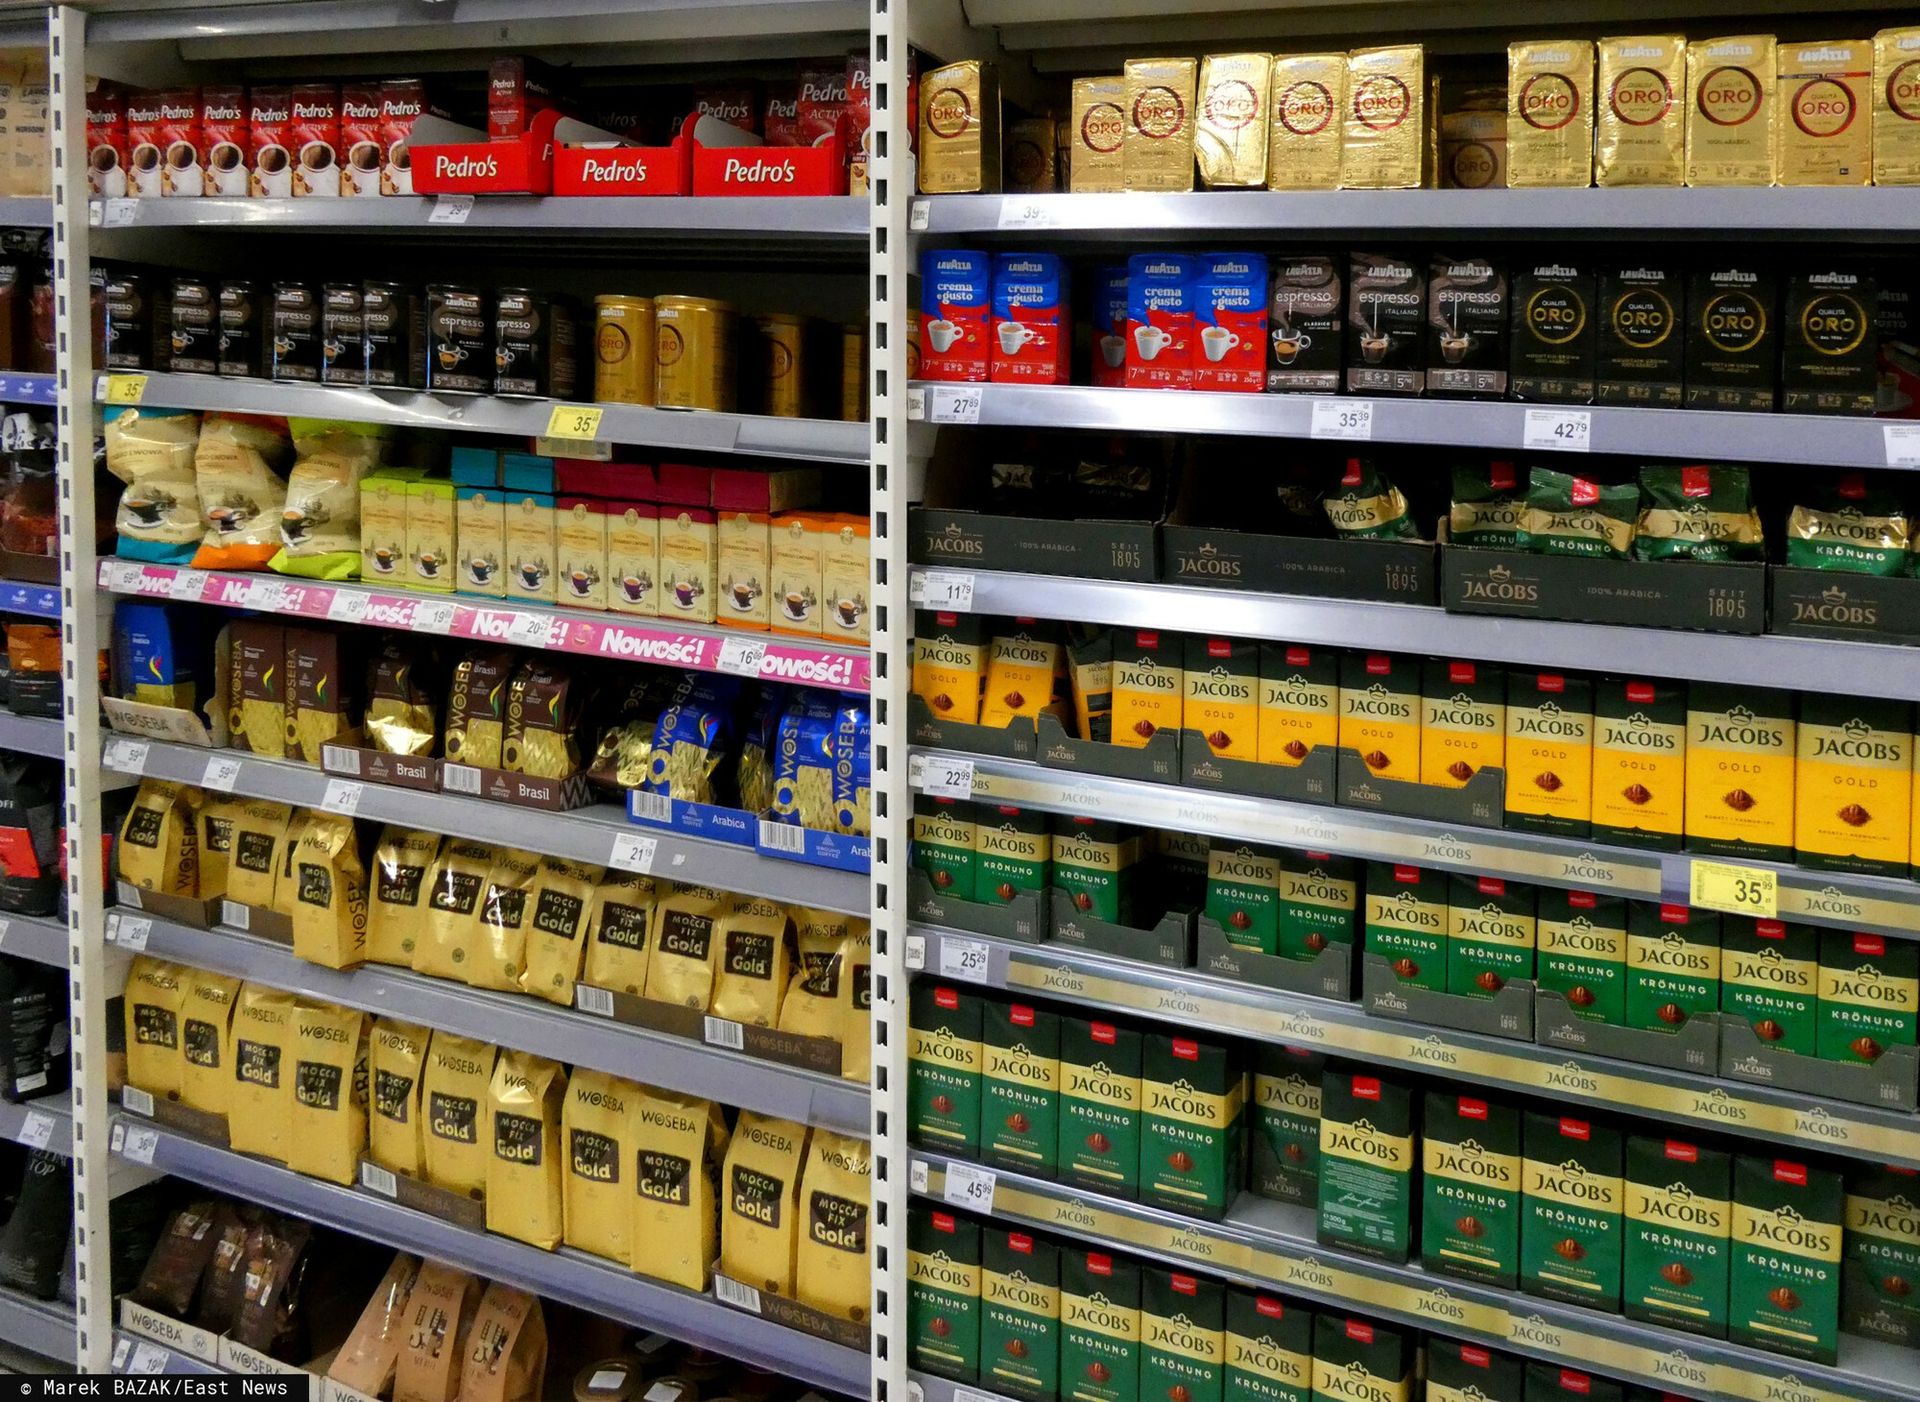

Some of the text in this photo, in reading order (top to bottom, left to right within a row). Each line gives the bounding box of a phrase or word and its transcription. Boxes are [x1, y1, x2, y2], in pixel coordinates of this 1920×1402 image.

[1798, 48, 1851, 61] LAVAZZA
[1362, 97, 1400, 109] ORO
[1529, 95, 1569, 109] ORO
[1619, 90, 1662, 104] ORO
[1707, 90, 1751, 104] ORO
[161, 105, 194, 119] Pedro's
[205, 105, 241, 120] Pedro's
[252, 107, 288, 122] Pedro's
[294, 103, 333, 119] Pedro's
[383, 101, 421, 116] Pedro's
[698, 101, 748, 119] Pedro's
[1140, 109, 1175, 119] ORO
[1802, 102, 1846, 115] ORO
[1089, 122, 1122, 133] ORO
[436, 155, 498, 179] Pedro's
[583, 159, 647, 182] Pedro's
[724, 158, 795, 183] Pedro's
[937, 260, 971, 270] LAVAZZA
[1711, 269, 1757, 282] LAVAZZA
[1809, 272, 1857, 283] LAVAZZA
[937, 283, 972, 292] crema
[1008, 285, 1043, 293] crema
[1145, 288, 1181, 297] crema
[1211, 286, 1250, 297] crema
[1276, 291, 1331, 304] espresso
[1360, 293, 1420, 305] espresso
[1439, 291, 1501, 304] espresso
[440, 317, 484, 329] espresso
[1534, 308, 1575, 322] ORO
[1620, 312, 1663, 326] ORO
[1711, 315, 1754, 329] ORO
[1809, 317, 1855, 331] ORO
[1112, 542, 1140, 551] SEIT
[1112, 551, 1140, 569] 1895
[1178, 558, 1241, 576] JACOBS
[1385, 573, 1417, 591] 1895
[1461, 582, 1538, 601] JACOBS
[1709, 589, 1745, 598] SEIT
[1709, 599, 1745, 619] 1895
[601, 625, 704, 664] Nowość!
[474, 665, 496, 675] Brasil
[1005, 672, 1031, 681] GOLD
[1119, 671, 1175, 689] JACOBS
[1191, 681, 1249, 698] JACOBS
[1132, 700, 1160, 709] GOLD
[1267, 690, 1328, 708] JACOBS
[1347, 699, 1410, 717] JACOBS
[1204, 710, 1234, 720] GOLD
[1281, 719, 1313, 729] GOLD
[1430, 708, 1495, 727] JACOBS
[1362, 728, 1393, 738] GOLD
[1516, 716, 1584, 736] JACOBS
[1445, 739, 1478, 749] GOLD
[1604, 728, 1675, 749] JACOBS
[1698, 724, 1783, 747] JACOBS
[1813, 737, 1901, 763] JACOBS
[397, 764, 426, 779] Brasil
[1620, 761, 1656, 771] GOLD
[1719, 762, 1761, 773] GOLD
[1834, 775, 1880, 789] GOLD
[519, 783, 550, 800] Brasil
[713, 814, 745, 829] Arabica
[919, 823, 971, 843] JACOBS
[983, 835, 1035, 855] JACOBS
[1059, 844, 1110, 864] JACOBS
[242, 852, 267, 868] Gold
[920, 848, 968, 865] KRÖNUNG
[984, 860, 1033, 876] KRÖNUNG
[1562, 865, 1613, 881] JACOBS
[1060, 870, 1108, 885] KRÖNUNG
[545, 893, 577, 908] MOCCA
[1216, 886, 1270, 904] KRÖNUNG
[1805, 897, 1861, 916] JACOBS
[538, 916, 573, 934] Gold
[1289, 909, 1346, 925] KRÖNUNG
[606, 924, 640, 946] Gold
[1377, 933, 1437, 950] KRÖNUNG
[667, 937, 703, 955] Gold
[1459, 947, 1522, 963] KRÖNUNG
[732, 958, 765, 974] Gold
[1639, 948, 1710, 970] JACOBS
[1549, 961, 1614, 978] KRÖNUNG
[1734, 962, 1808, 986] JACOBS
[1639, 977, 1707, 995] KRÖNUNG
[1735, 993, 1806, 1011] KRÖNUNG
[1831, 1009, 1904, 1029] KRÖNUNG
[138, 1026, 173, 1044] Gold
[1408, 1045, 1457, 1064] JACOBS
[242, 1063, 271, 1084] Gold
[917, 1067, 971, 1088] KRÖNUNG
[991, 1056, 1050, 1082] JACOBS
[1546, 1071, 1598, 1092] JACOBS
[297, 1084, 330, 1107] Gold
[437, 1098, 470, 1111] MOCCA
[577, 1088, 624, 1114] WOSEBA
[991, 1085, 1048, 1106] KRÖNUNG
[1071, 1105, 1130, 1126] KRÖNUNG
[1692, 1100, 1747, 1120] JACOBS
[434, 1119, 469, 1139] Gold
[641, 1110, 697, 1134] WOSEBA
[1794, 1119, 1849, 1140] JACOBS
[742, 1126, 792, 1154] WOSEBA
[1151, 1123, 1213, 1144] KRÖNUNG
[497, 1138, 534, 1158] Gold
[1328, 1132, 1399, 1162] JACOBS
[574, 1156, 611, 1179] Gold
[645, 1155, 682, 1172] MOCCA
[1434, 1152, 1510, 1182] JACOBS
[641, 1178, 682, 1201] Gold
[739, 1172, 775, 1193] MOCCA
[1436, 1185, 1507, 1208] KRÖNUNG
[735, 1198, 773, 1223] Gold
[819, 1198, 859, 1219] MOCCA
[1056, 1209, 1096, 1226] JACOBS
[1638, 1198, 1720, 1228] JACOBS
[1536, 1206, 1609, 1230] KRÖNUNG
[814, 1222, 856, 1248] Gold
[1641, 1231, 1717, 1255] KRÖNUNG
[1745, 1218, 1831, 1253] JACOBS
[914, 1261, 971, 1289] JACOBS
[1747, 1253, 1827, 1280] KRÖNUNG
[1288, 1267, 1333, 1286] JACOBS
[914, 1290, 969, 1312] KRÖNUNG
[1416, 1298, 1464, 1318] JACOBS
[130, 1311, 183, 1340] WOSEBA
[991, 1311, 1047, 1332] KRÖNUNG
[1070, 1334, 1128, 1356] KRÖNUNG
[1513, 1325, 1561, 1347] JACOBS
[1151, 1356, 1212, 1379] KRÖNUNG
[1654, 1360, 1706, 1383] JACOBS
[1235, 1376, 1297, 1402] KRÖNUNG
